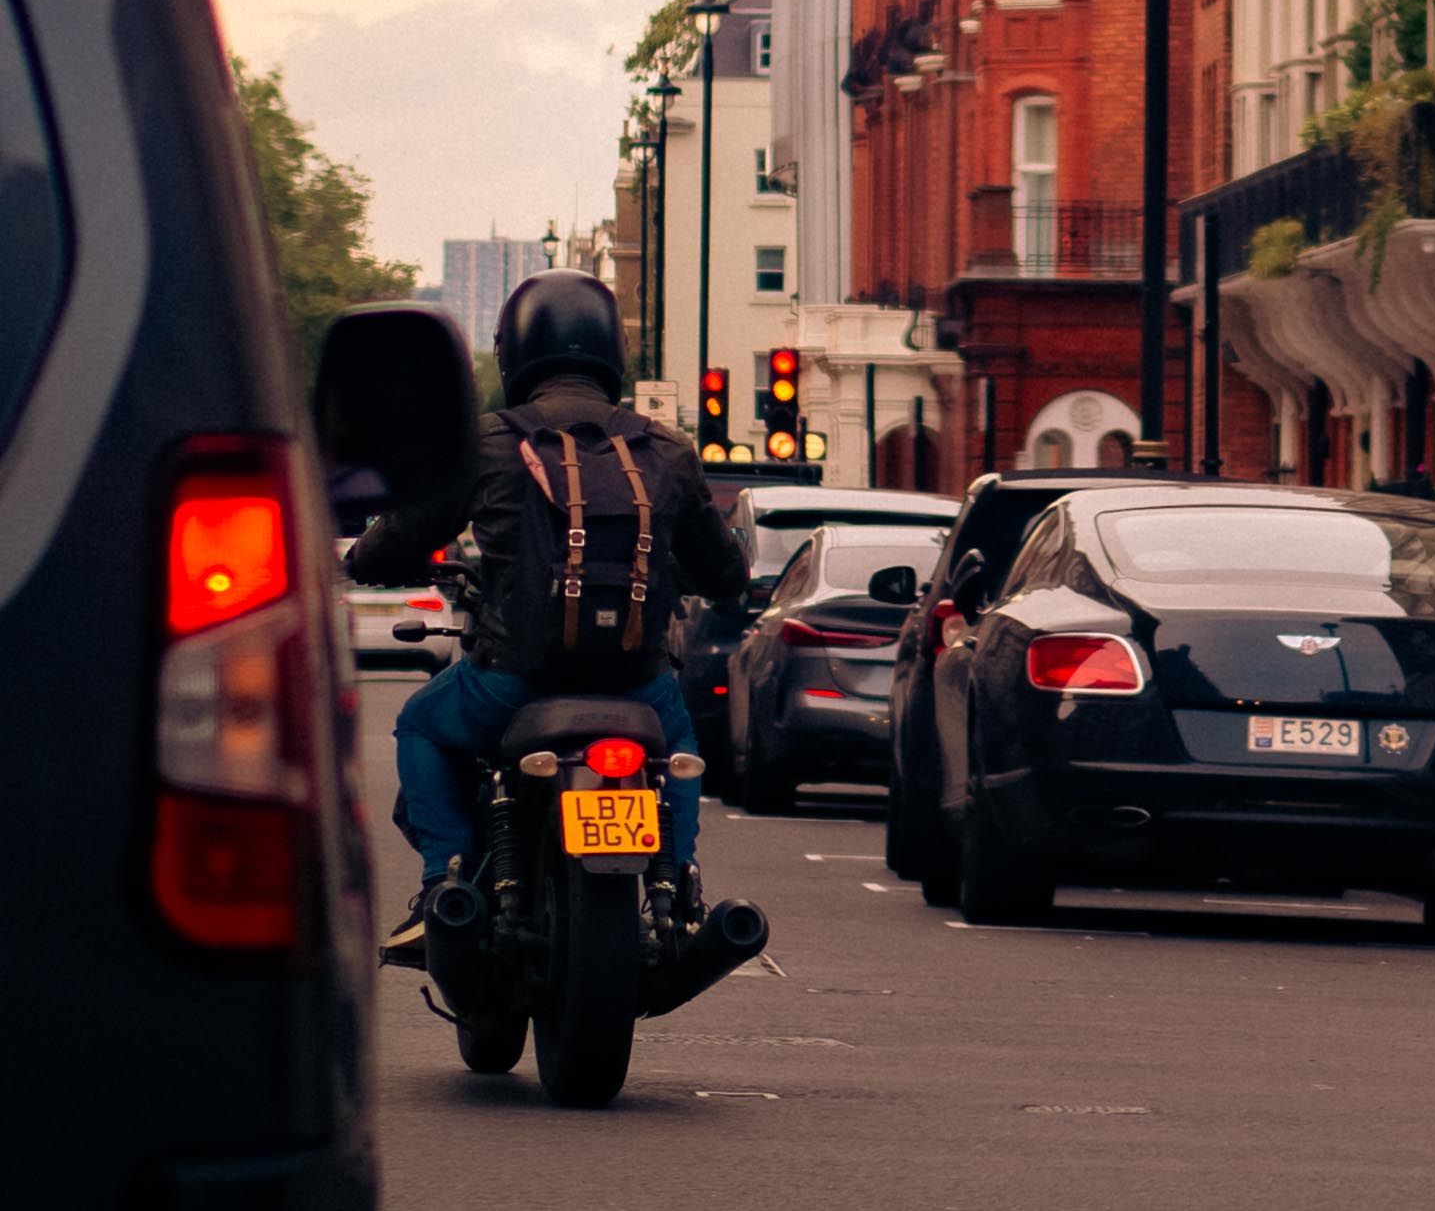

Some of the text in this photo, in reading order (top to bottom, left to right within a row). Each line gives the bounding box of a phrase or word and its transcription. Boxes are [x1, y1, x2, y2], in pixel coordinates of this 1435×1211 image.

[1281, 720, 1353, 746] E529
[575, 796, 645, 821] LB71
[582, 821, 645, 847] BGY
